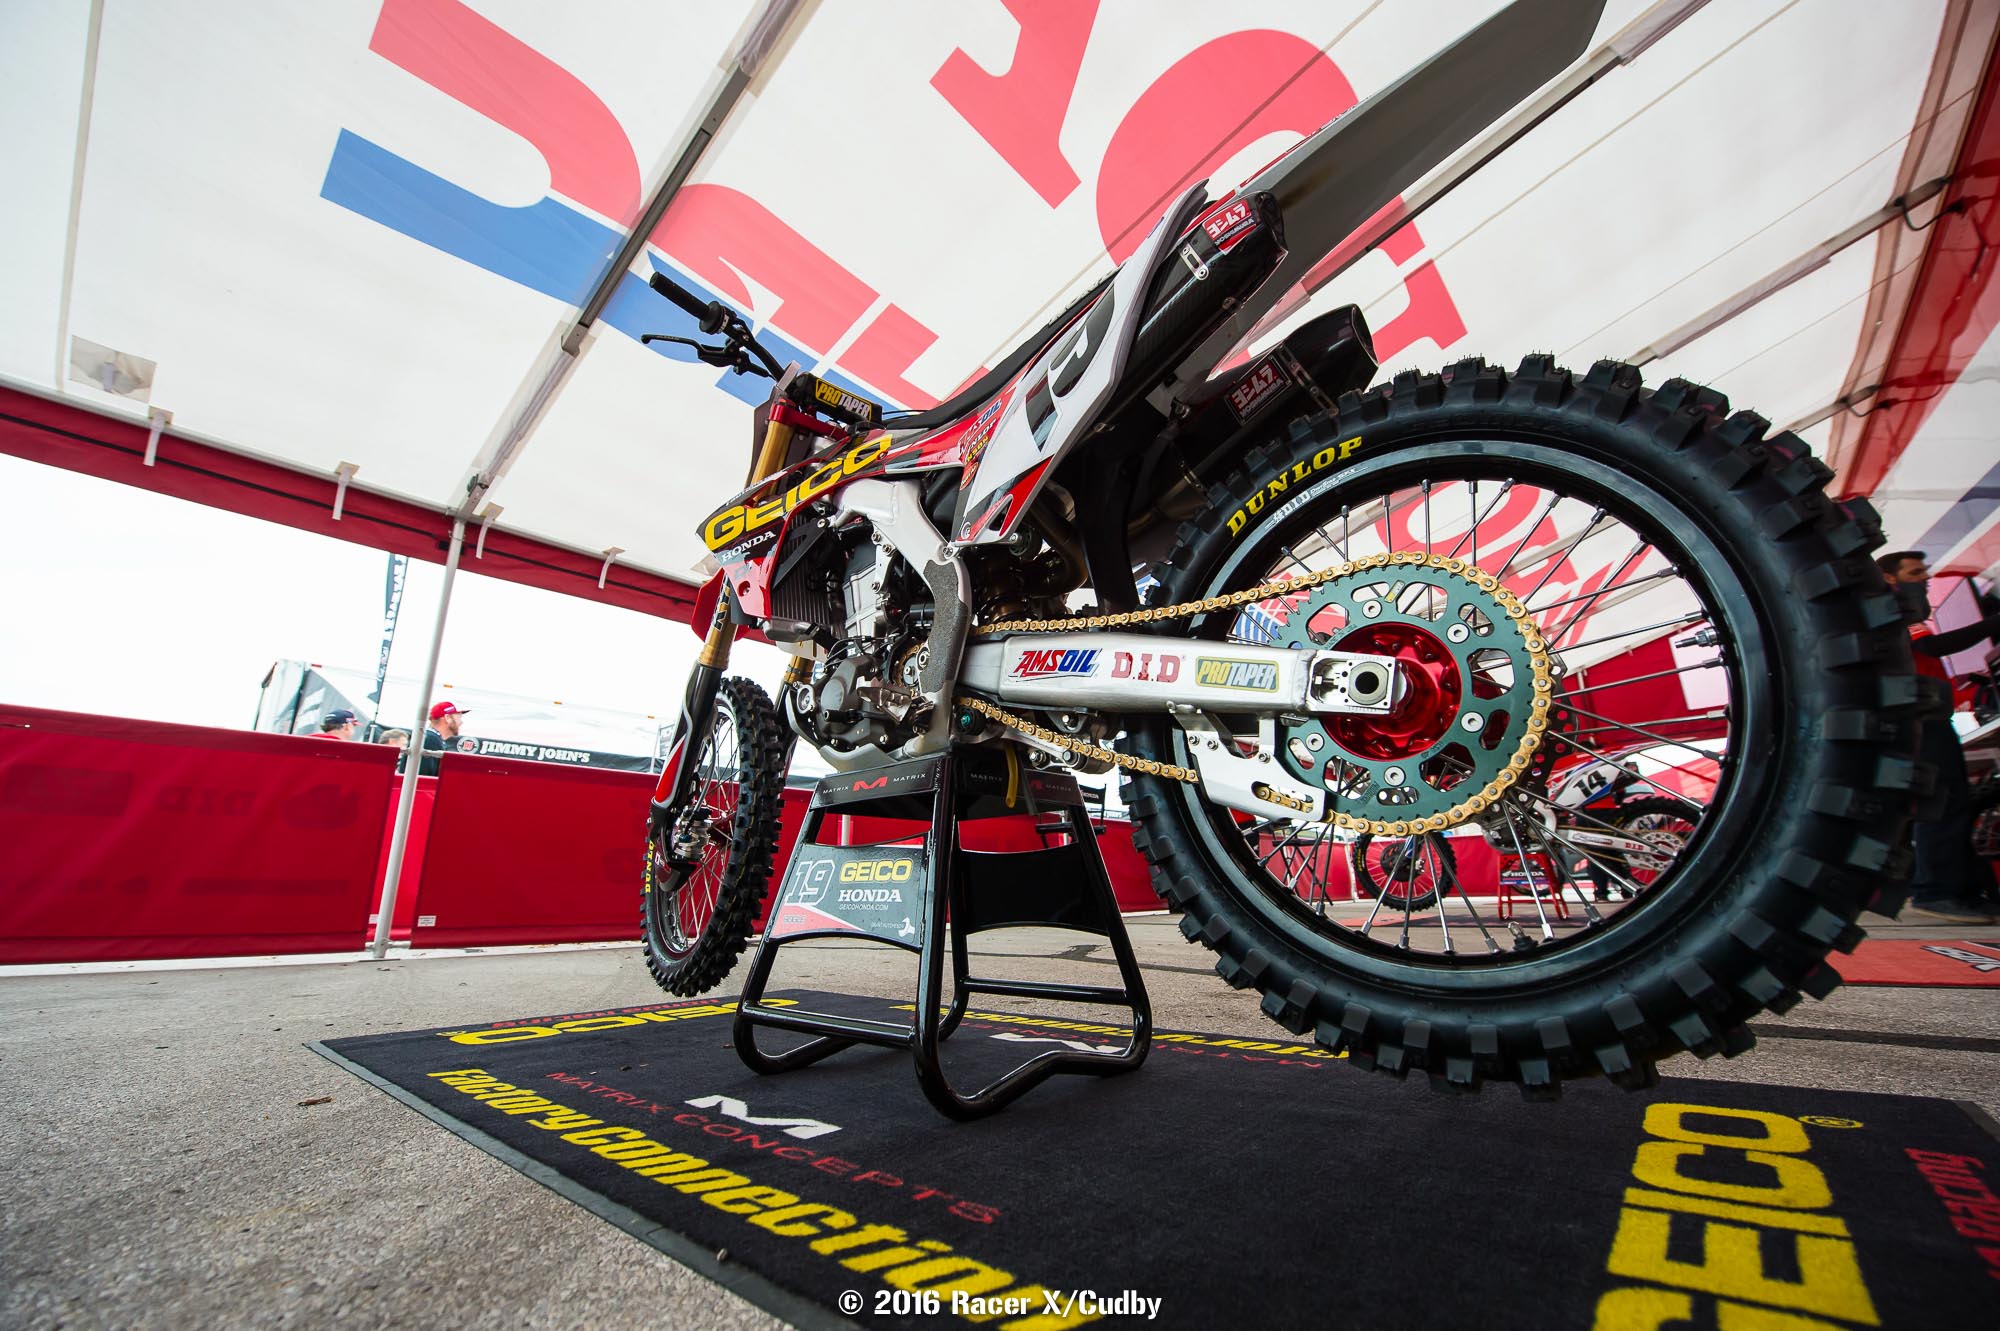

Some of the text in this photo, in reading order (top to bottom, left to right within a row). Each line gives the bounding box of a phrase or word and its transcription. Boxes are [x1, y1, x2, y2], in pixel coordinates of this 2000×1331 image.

[1206, 203, 1250, 239] ヨシムラ
[817, 382, 870, 422] PROTAPER
[1232, 364, 1277, 409] ヨシムラ
[705, 434, 893, 551] GEICO
[1227, 436, 1362, 538] DUNLOP
[721, 530, 777, 563] HONDA
[1012, 649, 1277, 690] AMSOIL D.I.D PROTAPER
[480, 740, 592, 763] JIMMY JOHN'S
[823, 785, 850, 794] MATRIX
[893, 773, 927, 783] MATRIX
[1573, 770, 1608, 798] 14
[645, 840, 655, 893] DUNLO
[784, 859, 836, 906] 19
[839, 858, 913, 884] GEICO
[838, 889, 902, 903] HONDA
[546, 1072, 1003, 1225] MATRIX CONCEPTS
